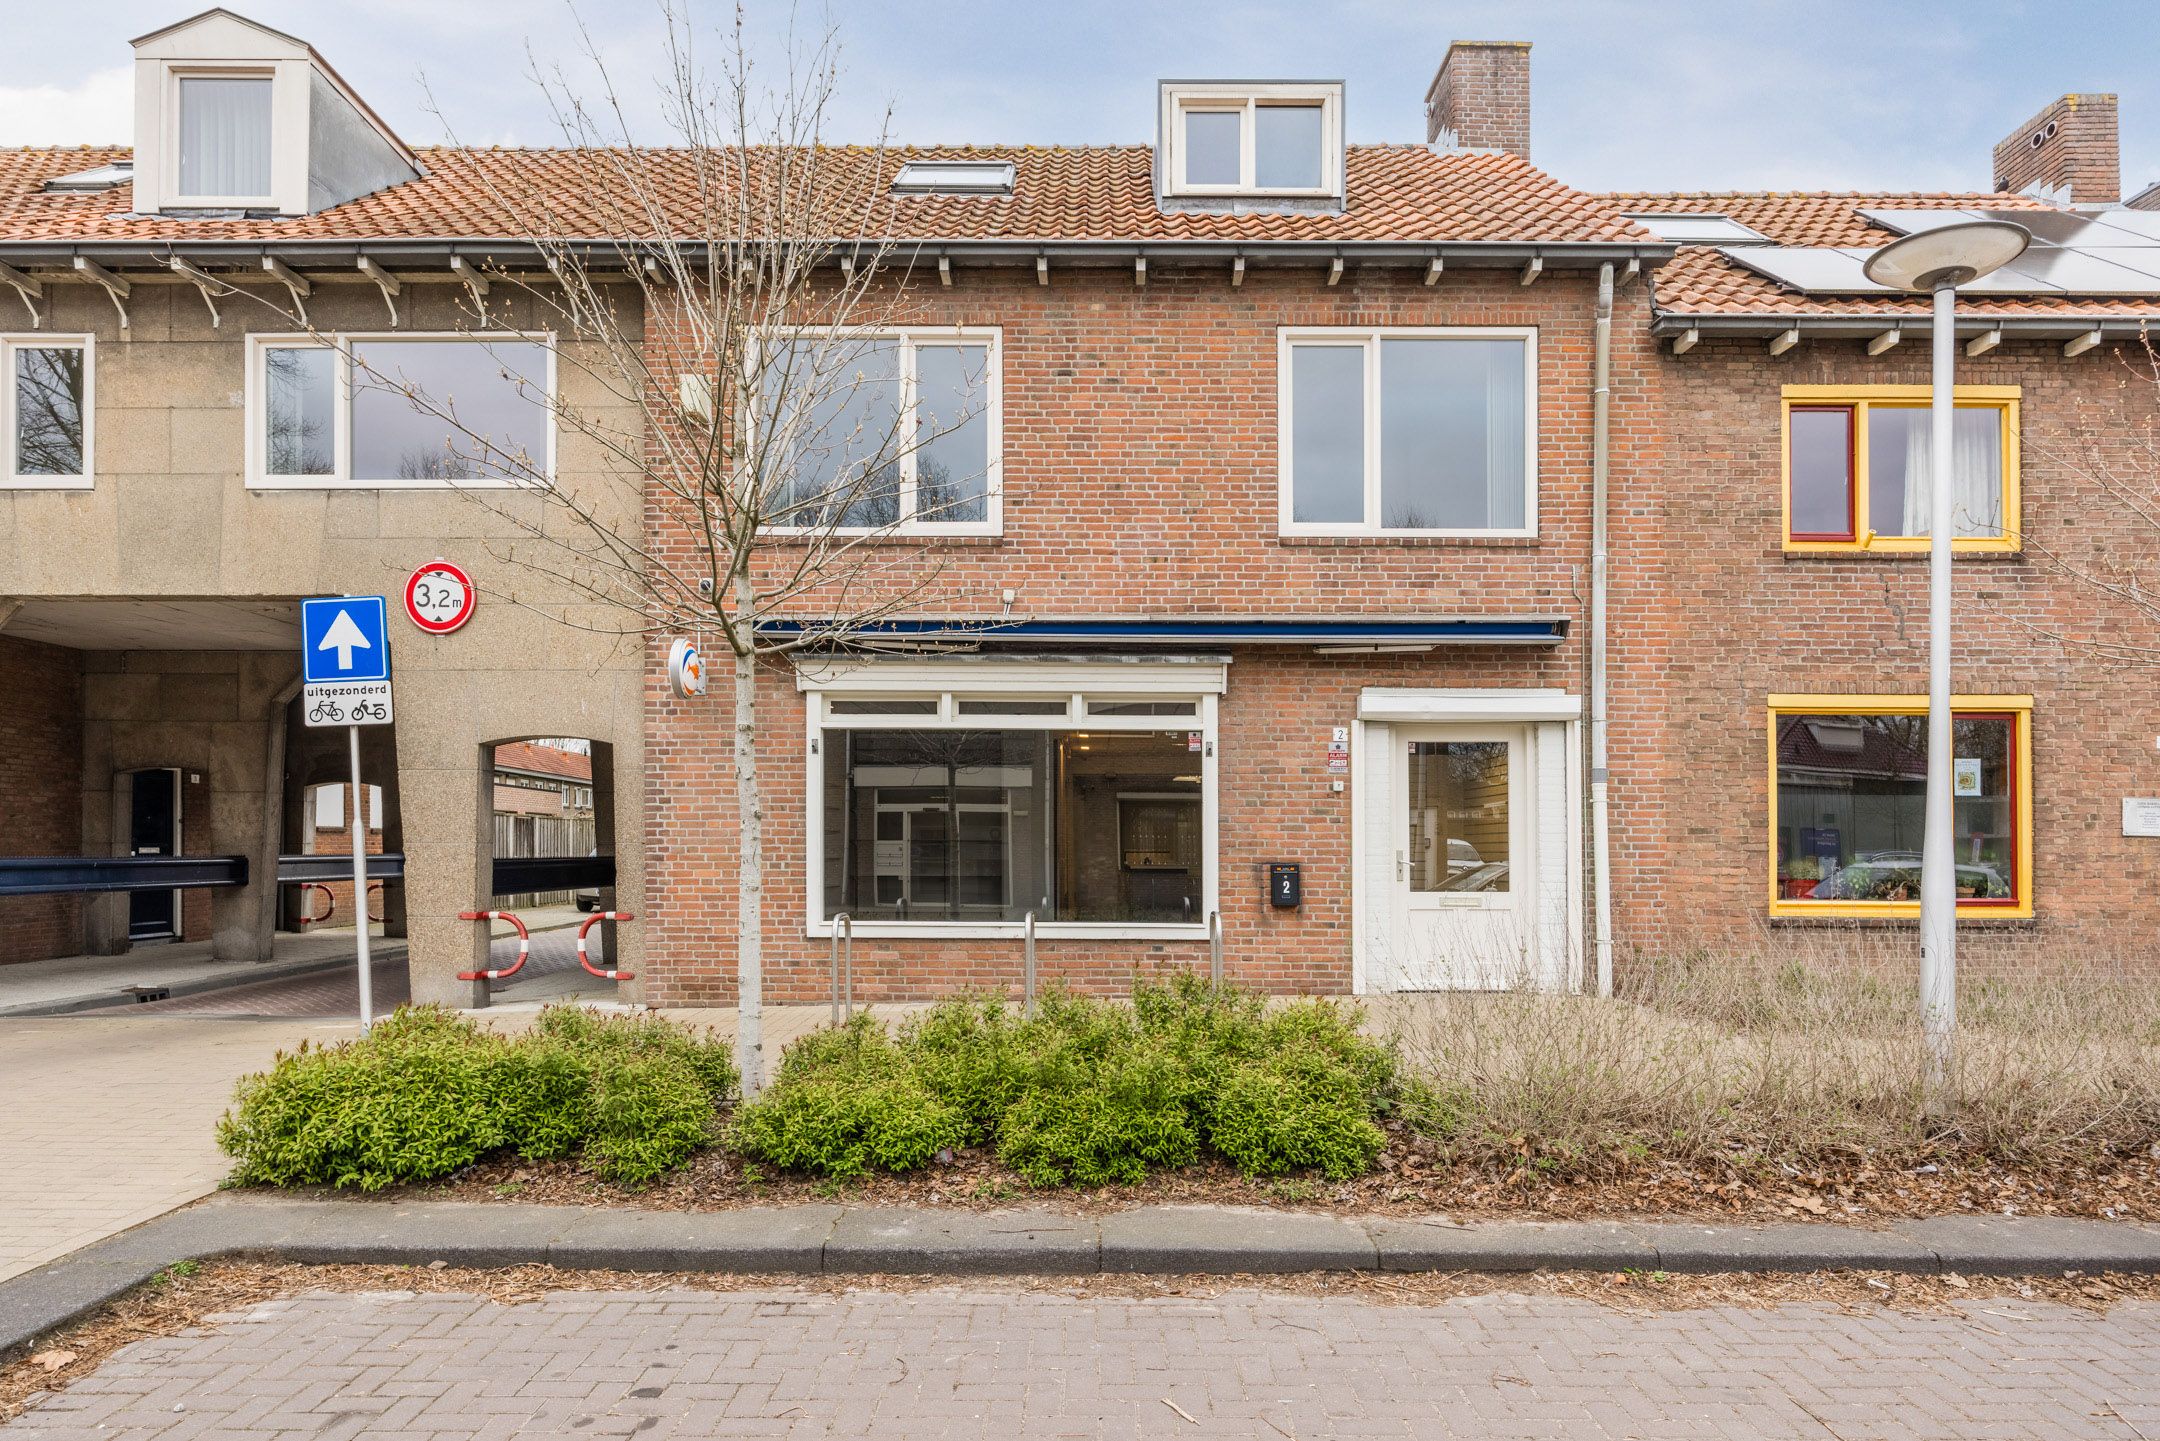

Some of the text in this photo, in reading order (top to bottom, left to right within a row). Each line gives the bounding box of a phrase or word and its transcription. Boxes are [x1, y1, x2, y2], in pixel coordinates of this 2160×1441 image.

[416, 583, 462, 609] 3,2m
[307, 684, 387, 698] uitgezonderd
[1338, 730, 1344, 739] 2
[1283, 880, 1290, 893] 2
